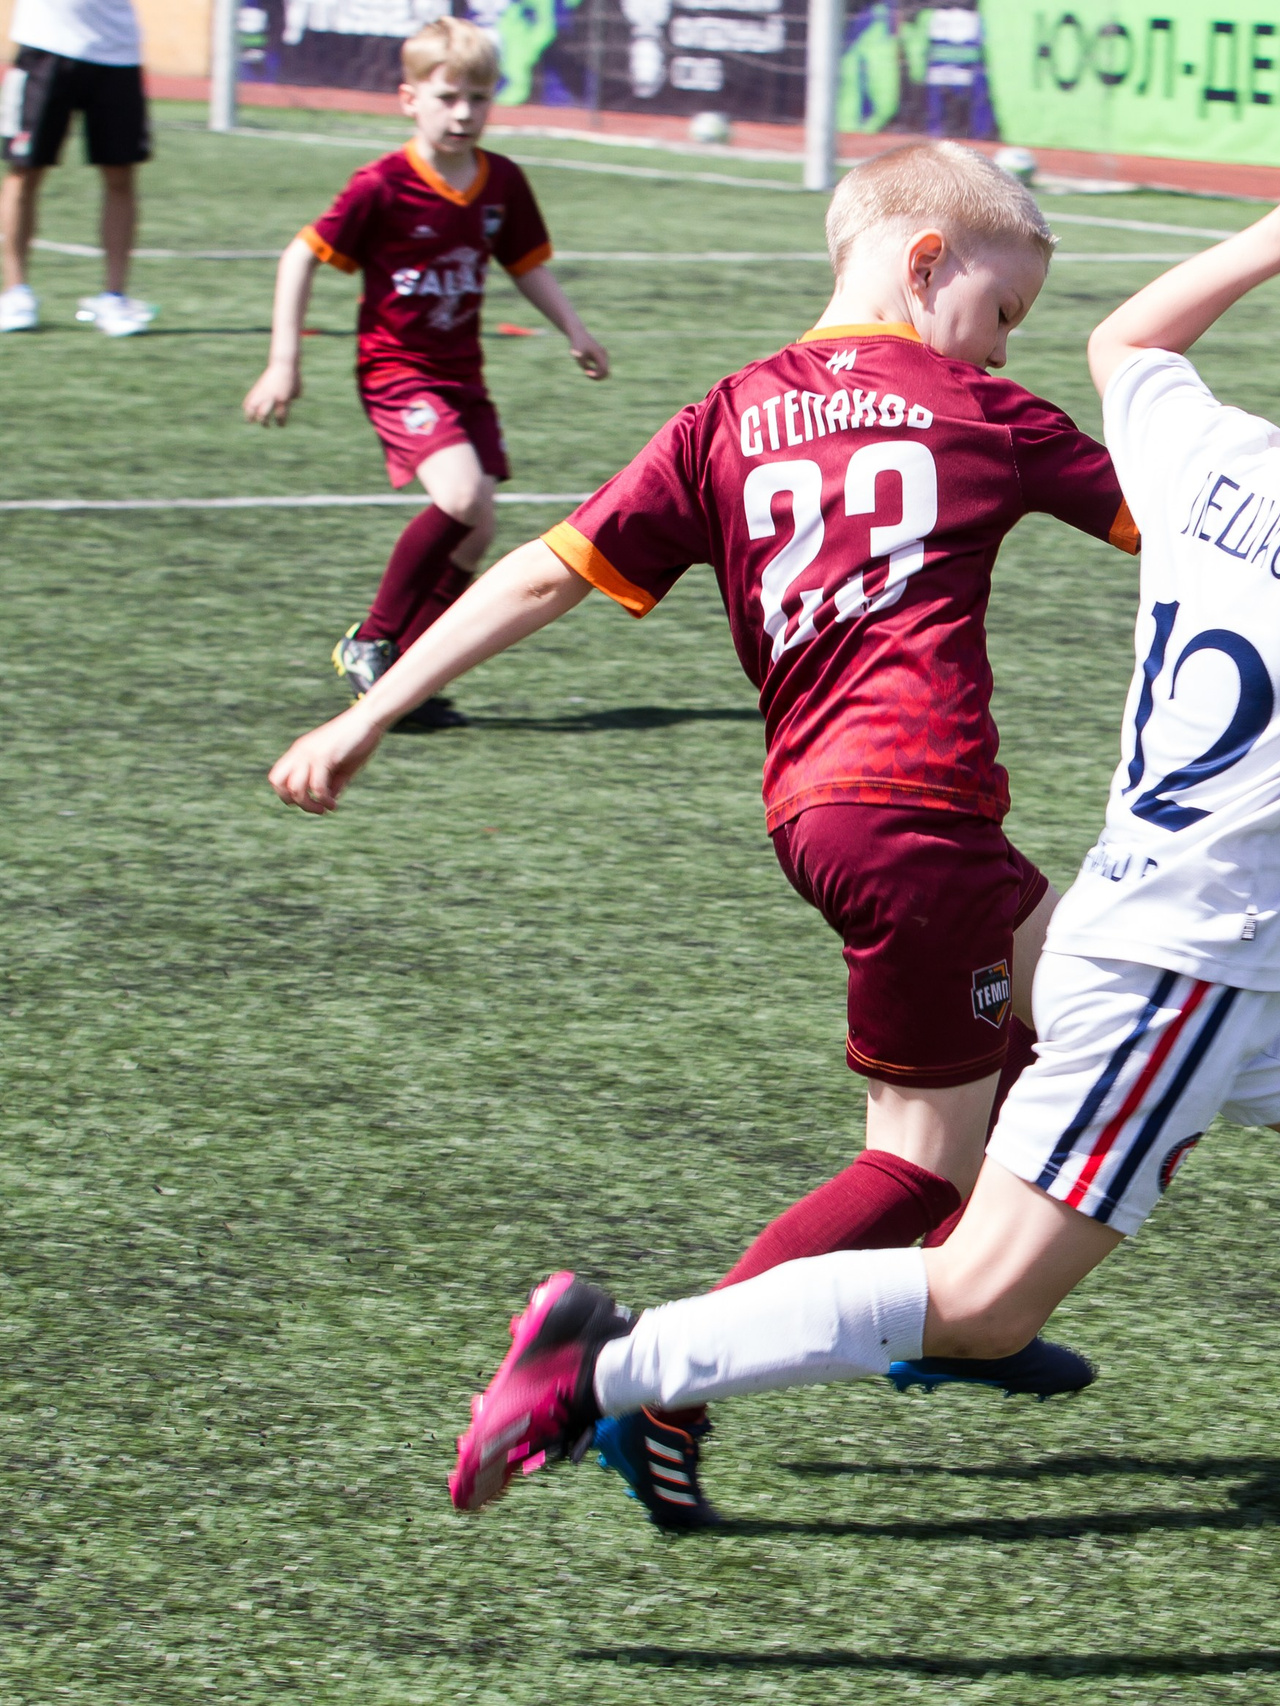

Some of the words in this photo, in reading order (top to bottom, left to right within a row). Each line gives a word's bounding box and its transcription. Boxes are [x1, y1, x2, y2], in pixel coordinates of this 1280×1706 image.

[743, 440, 939, 664] 23
[1121, 600, 1276, 833] 12
[975, 979, 1009, 1010] ТЕМП
